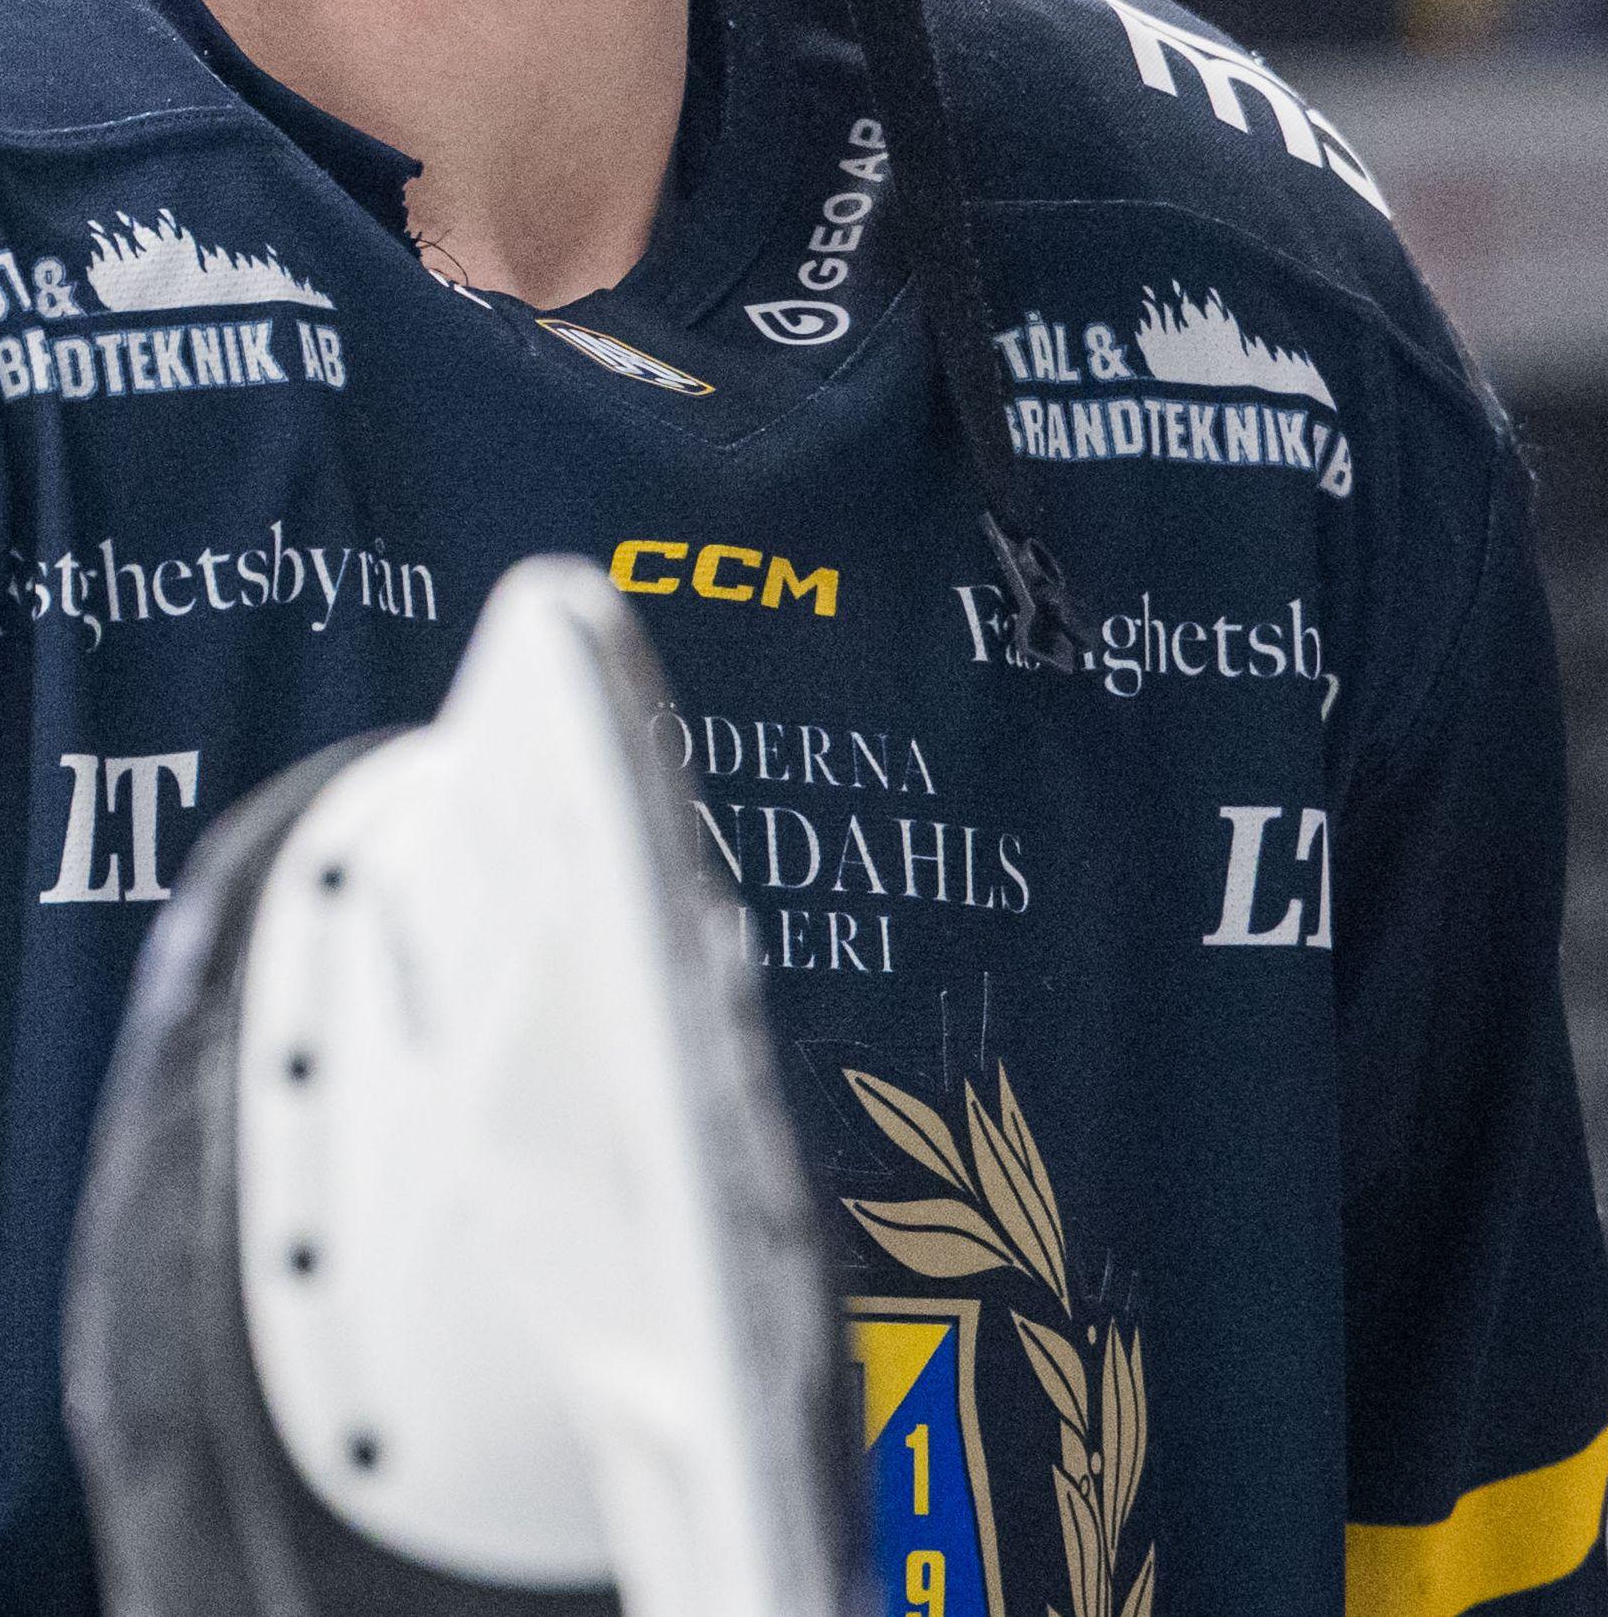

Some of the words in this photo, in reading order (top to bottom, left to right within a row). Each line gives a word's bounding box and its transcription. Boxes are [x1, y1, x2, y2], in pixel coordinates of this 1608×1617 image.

[798, 191, 874, 292] GEO
[33, 256, 85, 320] &
[297, 322, 345, 391] AB
[993, 308, 1080, 383] TÅL
[1084, 324, 1134, 382] &
[608, 538, 841, 618] CCM
[648, 700, 937, 796] ÖDERNA
[38, 749, 201, 905] LT
[688, 799, 1031, 916] NDAHLS
